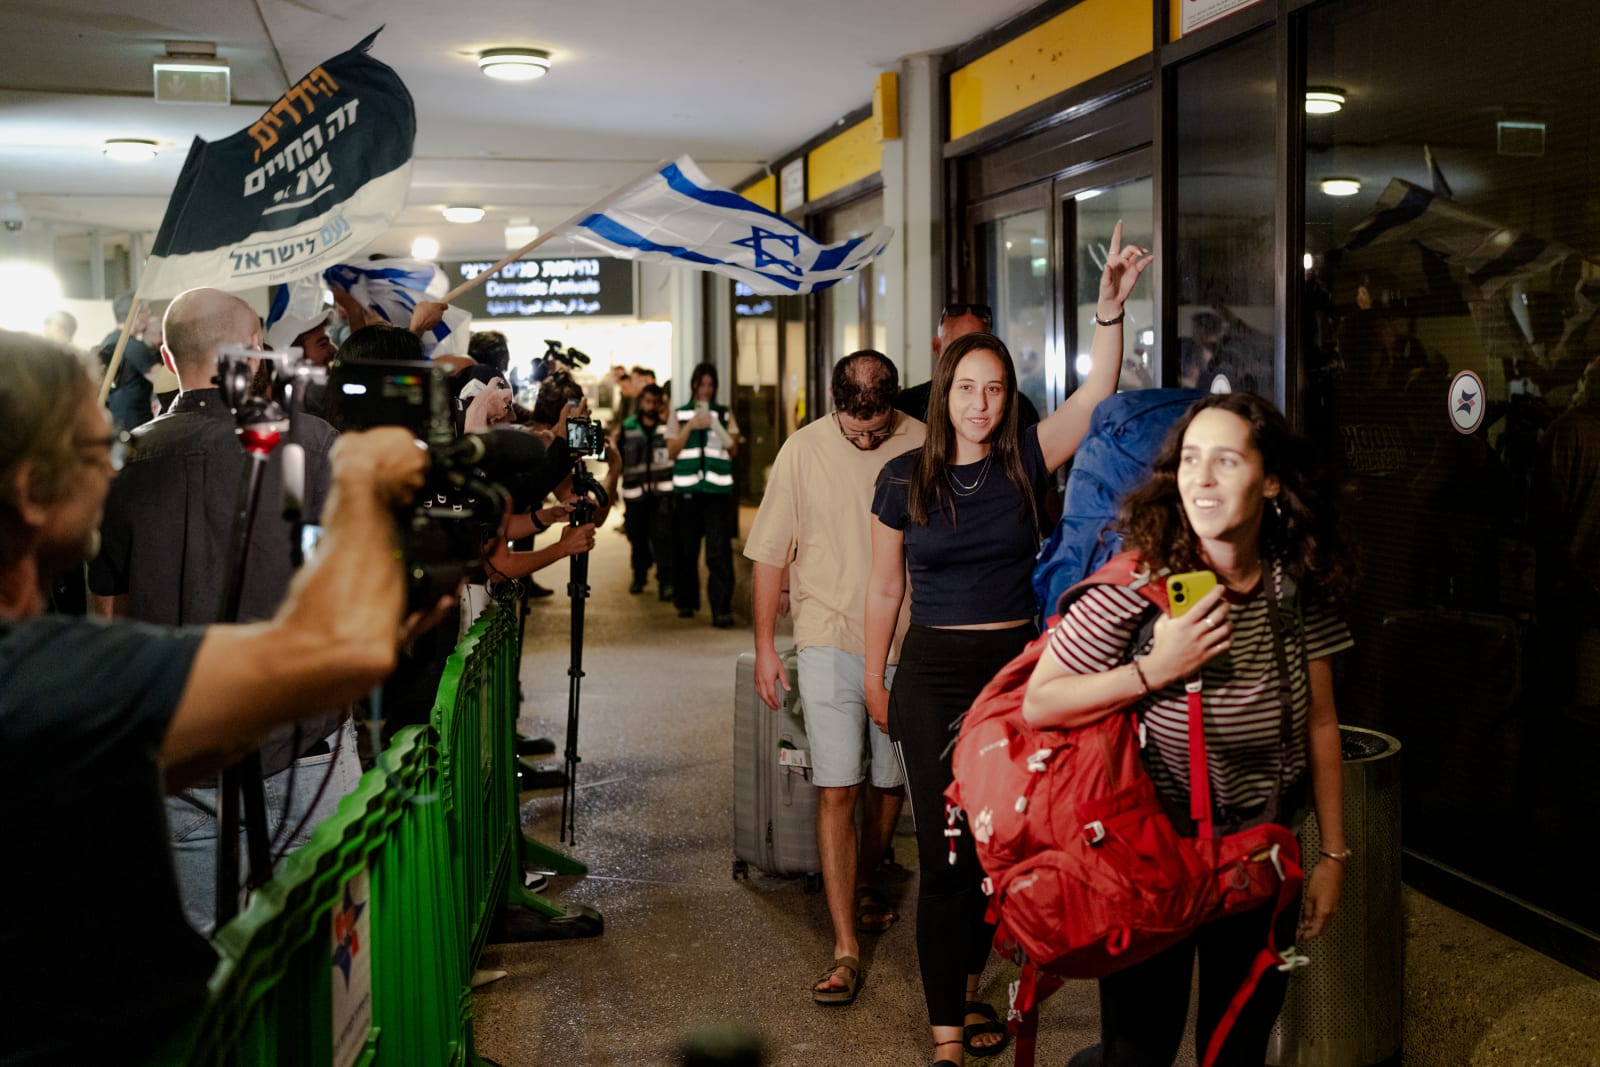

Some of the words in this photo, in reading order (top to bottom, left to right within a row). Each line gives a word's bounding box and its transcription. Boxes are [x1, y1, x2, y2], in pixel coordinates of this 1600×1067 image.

[325, 98, 359, 141] זה
[243, 124, 323, 197] החיים
[320, 212, 350, 246] נעם
[229, 237, 316, 271] לישראל
